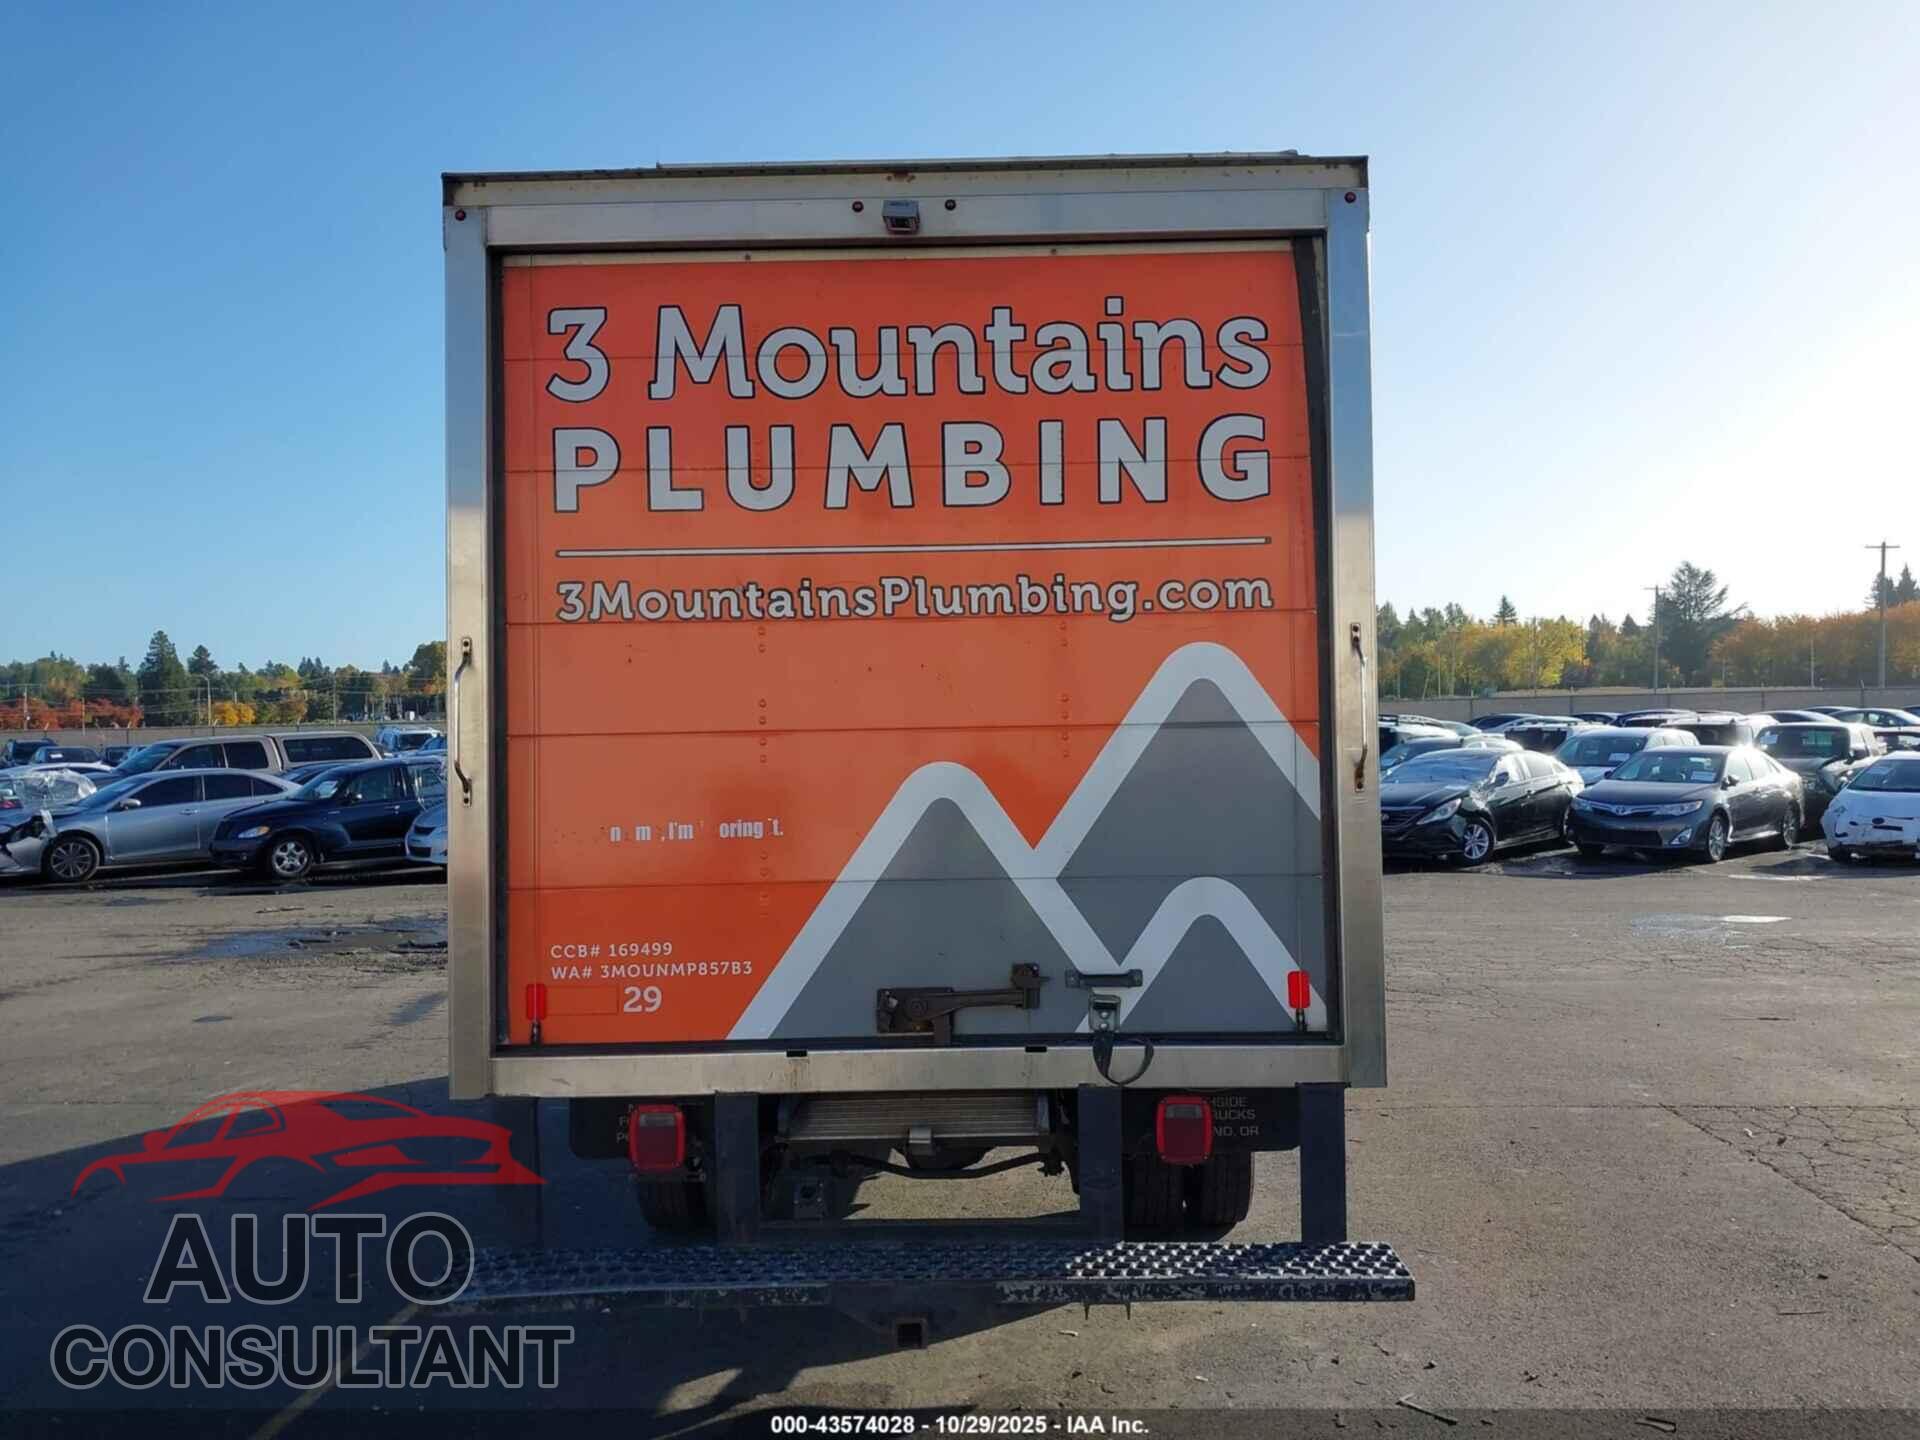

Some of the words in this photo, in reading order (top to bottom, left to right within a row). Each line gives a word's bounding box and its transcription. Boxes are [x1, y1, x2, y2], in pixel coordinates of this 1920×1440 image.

[545, 306, 610, 403] 3
[648, 295, 1270, 400] Mountains
[553, 413, 1270, 512] PLUMBING
[558, 574, 1274, 623] 3MountainsPlumbing.com
[551, 944, 600, 959] CCB#
[608, 942, 673, 957] 169499
[551, 965, 593, 979] WA#
[600, 961, 753, 978] 3MOUNMP857B3
[623, 986, 662, 1013] 29
